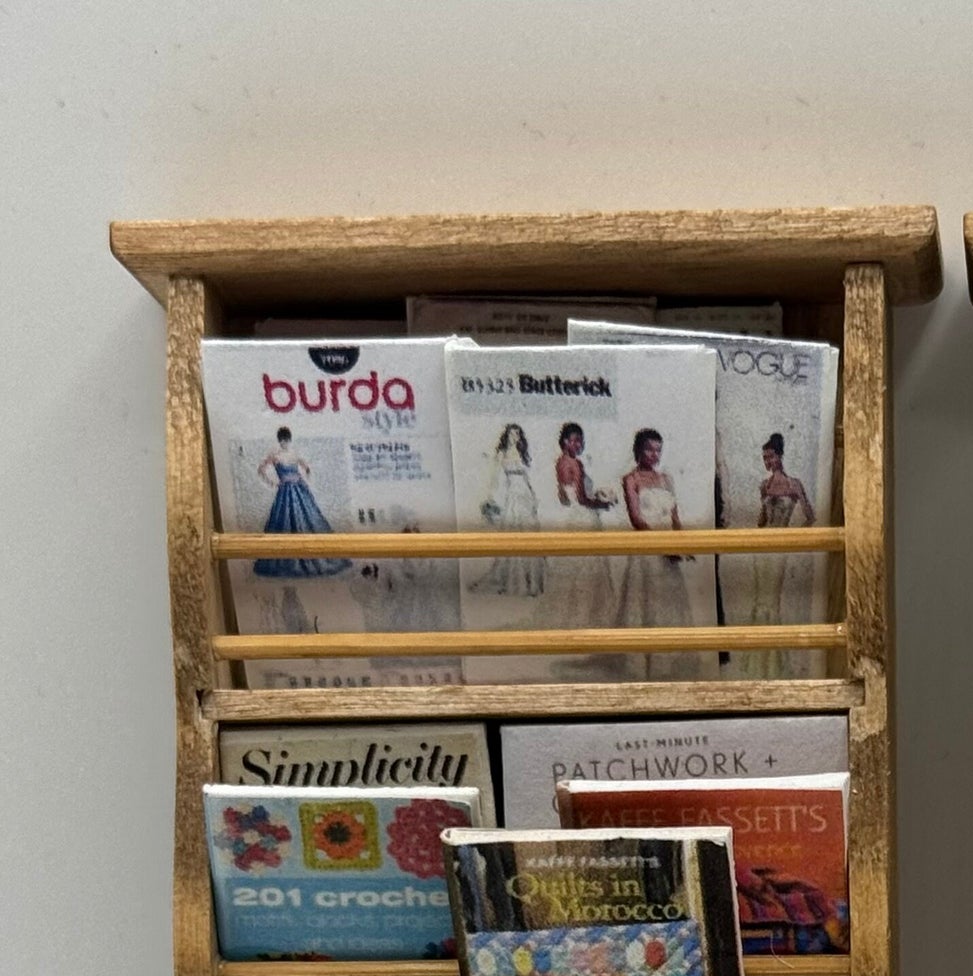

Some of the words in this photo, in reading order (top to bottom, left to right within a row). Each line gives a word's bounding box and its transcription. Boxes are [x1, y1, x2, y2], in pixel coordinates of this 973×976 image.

[716, 346, 811, 380] VOGUE
[262, 370, 416, 414] burda
[519, 373, 613, 398] Butterick
[239, 742, 469, 787] Simplicity
[552, 750, 749, 783] PATCHWORK
[232, 886, 301, 908] 201
[314, 885, 450, 908] croche
[612, 873, 641, 897] in
[550, 897, 684, 926] Morocco
